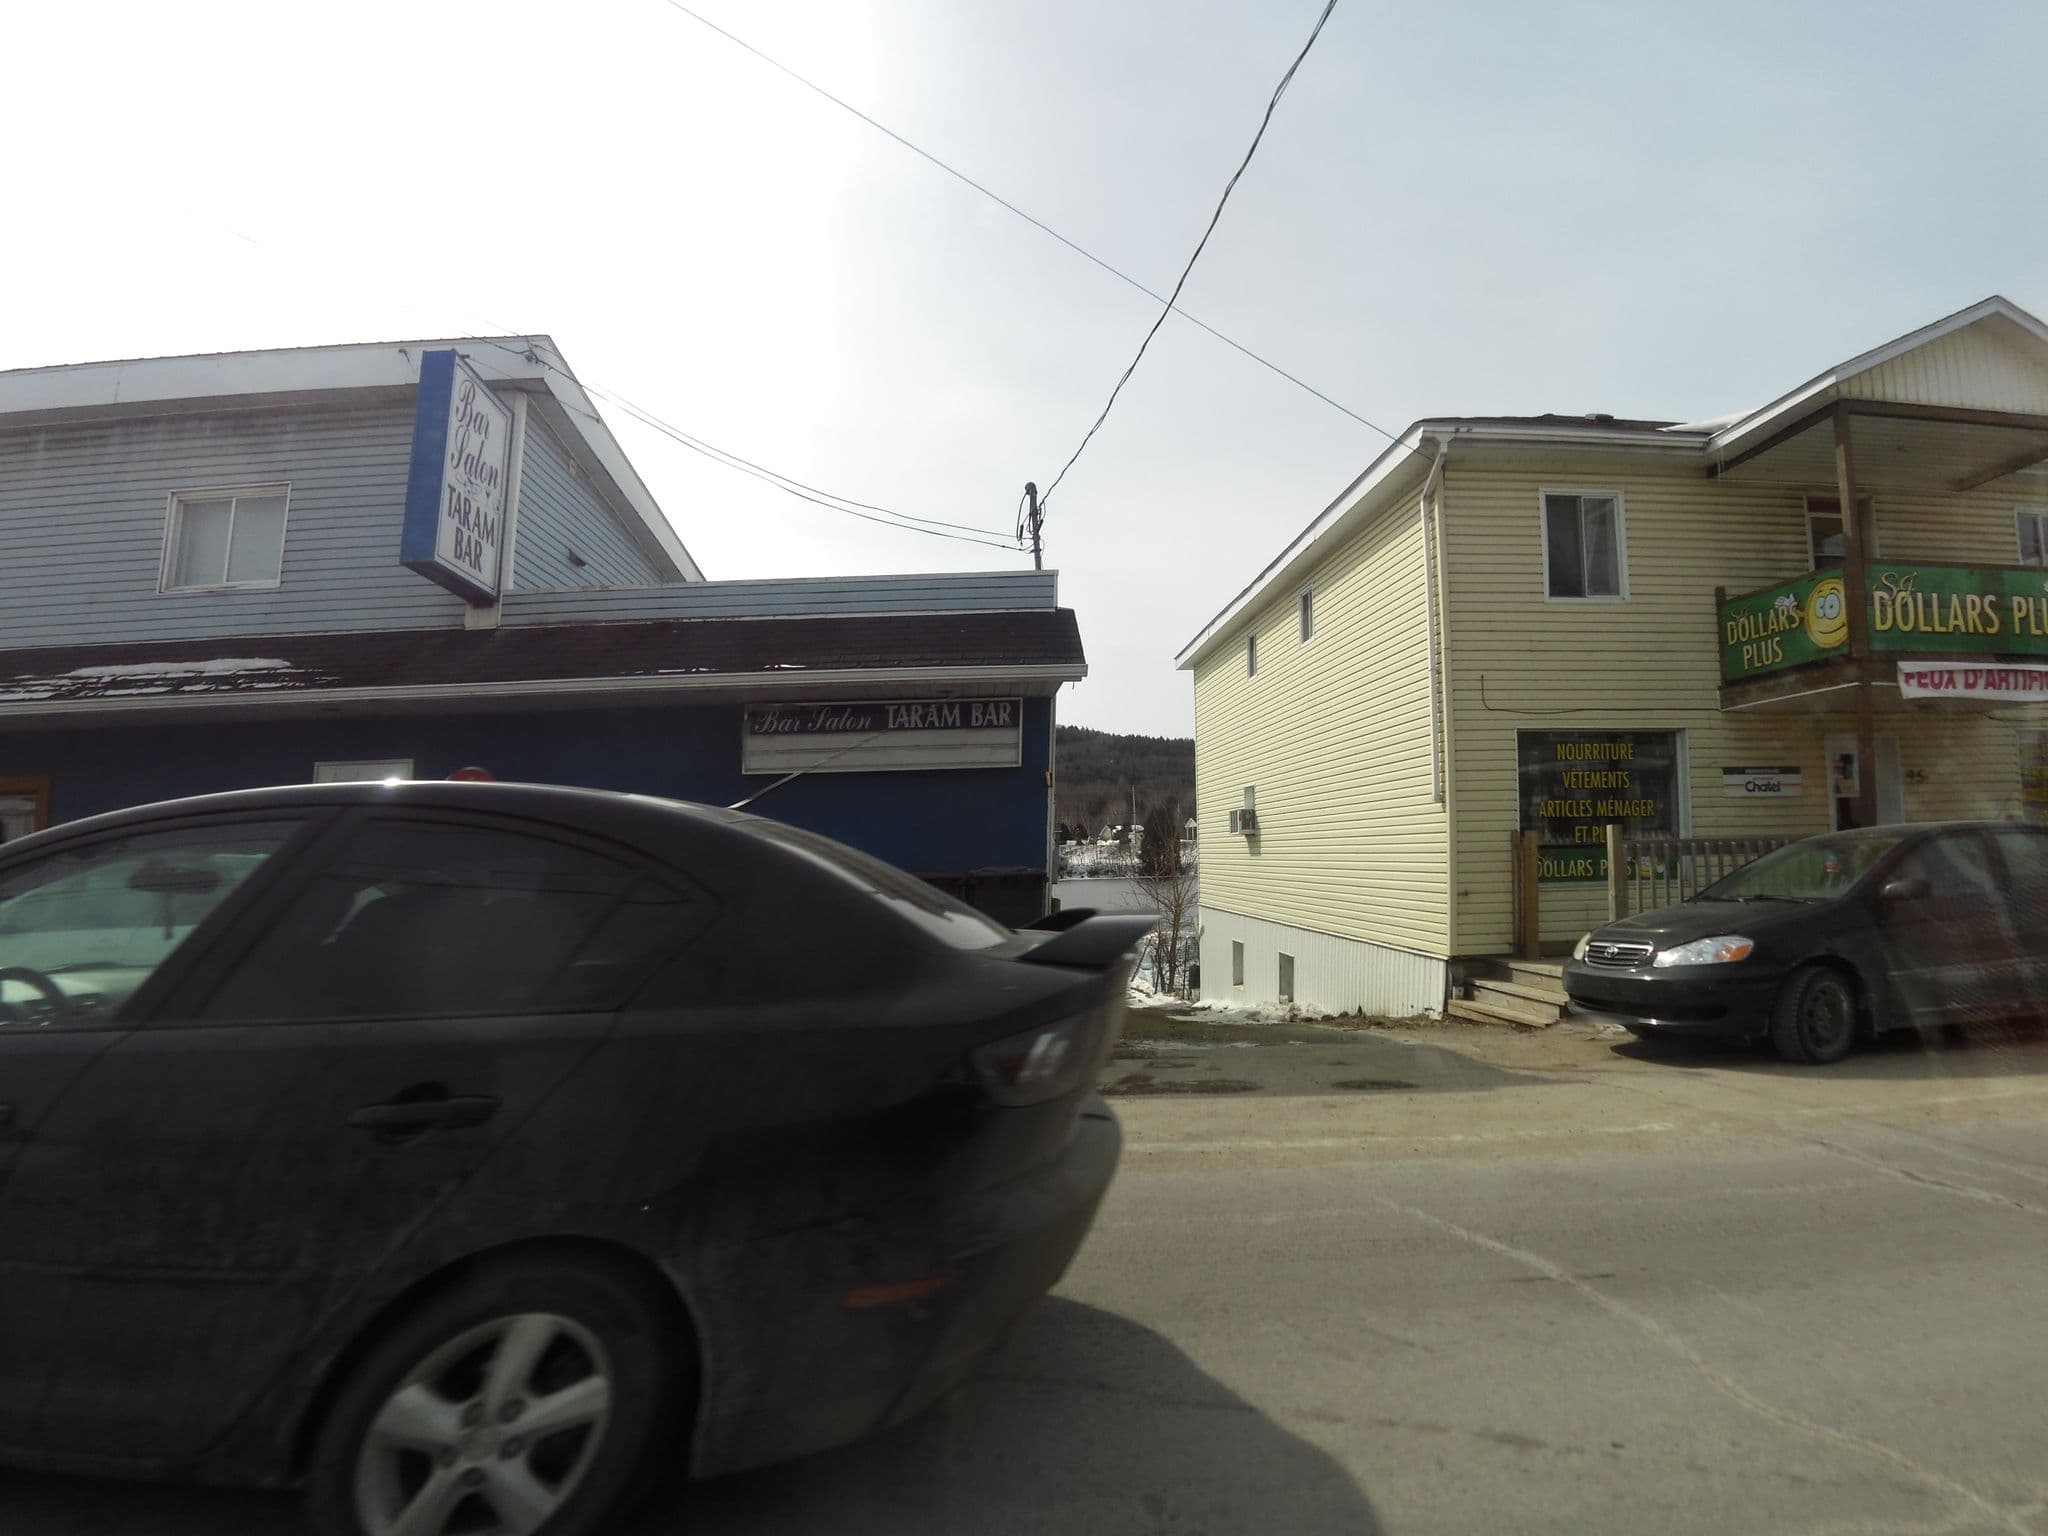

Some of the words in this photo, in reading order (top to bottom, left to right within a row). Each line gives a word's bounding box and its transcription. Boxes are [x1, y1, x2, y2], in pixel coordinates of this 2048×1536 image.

[456, 379, 490, 441] Bar
[451, 424, 499, 491] Salon
[448, 484, 495, 548] TARAM
[454, 528, 484, 573] BAR
[1727, 602, 1800, 646] DOLLARS
[1873, 590, 2000, 635] DOLLARS
[1743, 637, 1783, 670] PLUS
[1964, 669, 2048, 691] D'ARTIFI
[754, 711, 801, 734] Bar
[807, 706, 872, 731] Salon
[886, 704, 961, 729] TARAM
[971, 702, 1012, 727] BAR
[1556, 743, 1635, 760] NOURRITURE
[1562, 768, 1631, 789] VÊTEMENTS
[1538, 800, 1593, 818] ARTICLES
[1597, 796, 1654, 817] MÉNAGER
[1575, 826, 1588, 843] ET
